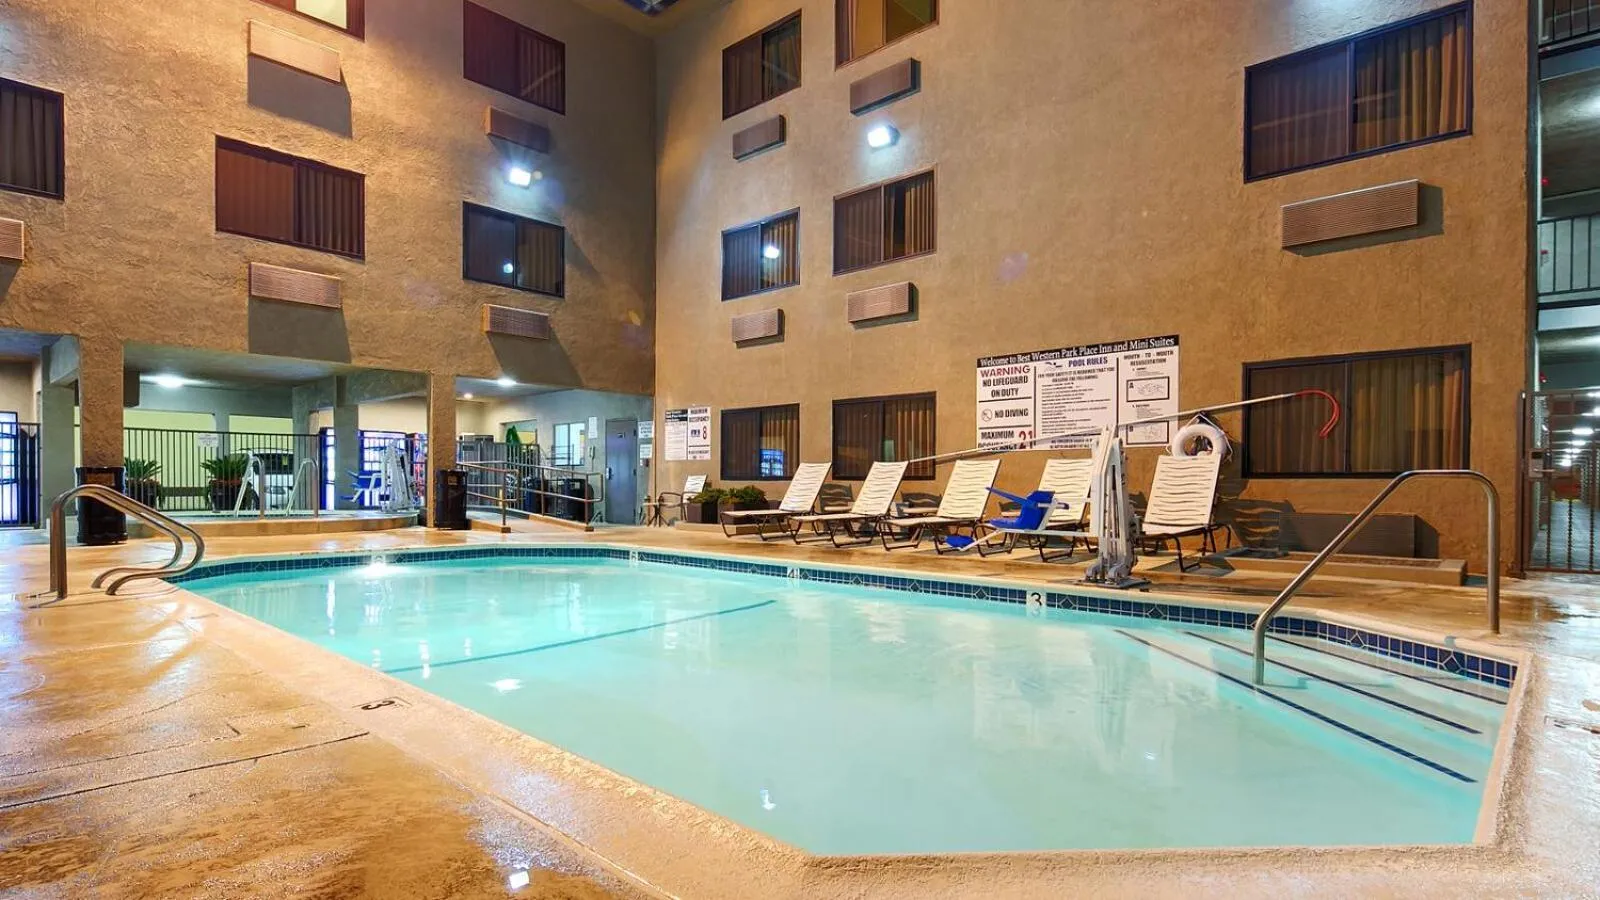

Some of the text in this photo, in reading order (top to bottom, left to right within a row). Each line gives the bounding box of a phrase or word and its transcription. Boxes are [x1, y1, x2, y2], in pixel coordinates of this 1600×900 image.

[980, 356, 1008, 367] Welcome
[1017, 354, 1030, 362] Best
[1031, 351, 1060, 361] Western
[1061, 347, 1077, 358] Park
[1079, 346, 1097, 356] Place
[1099, 344, 1112, 353] Inn
[1113, 342, 1128, 352] and
[1129, 339, 1148, 350] Mini
[1149, 337, 1174, 348] Suites
[1068, 357, 1108, 367] POOL RULES
[980, 365, 1030, 377] WARNING
[982, 376, 1028, 387] NO LIFEGUARD
[991, 388, 1019, 397] ON DUTY
[995, 408, 1028, 418] NO DIVING
[703, 425, 707, 440] 8
[981, 430, 1015, 439] MAXIMUM
[1030, 591, 1042, 606] 3
[361, 700, 395, 710] 3
